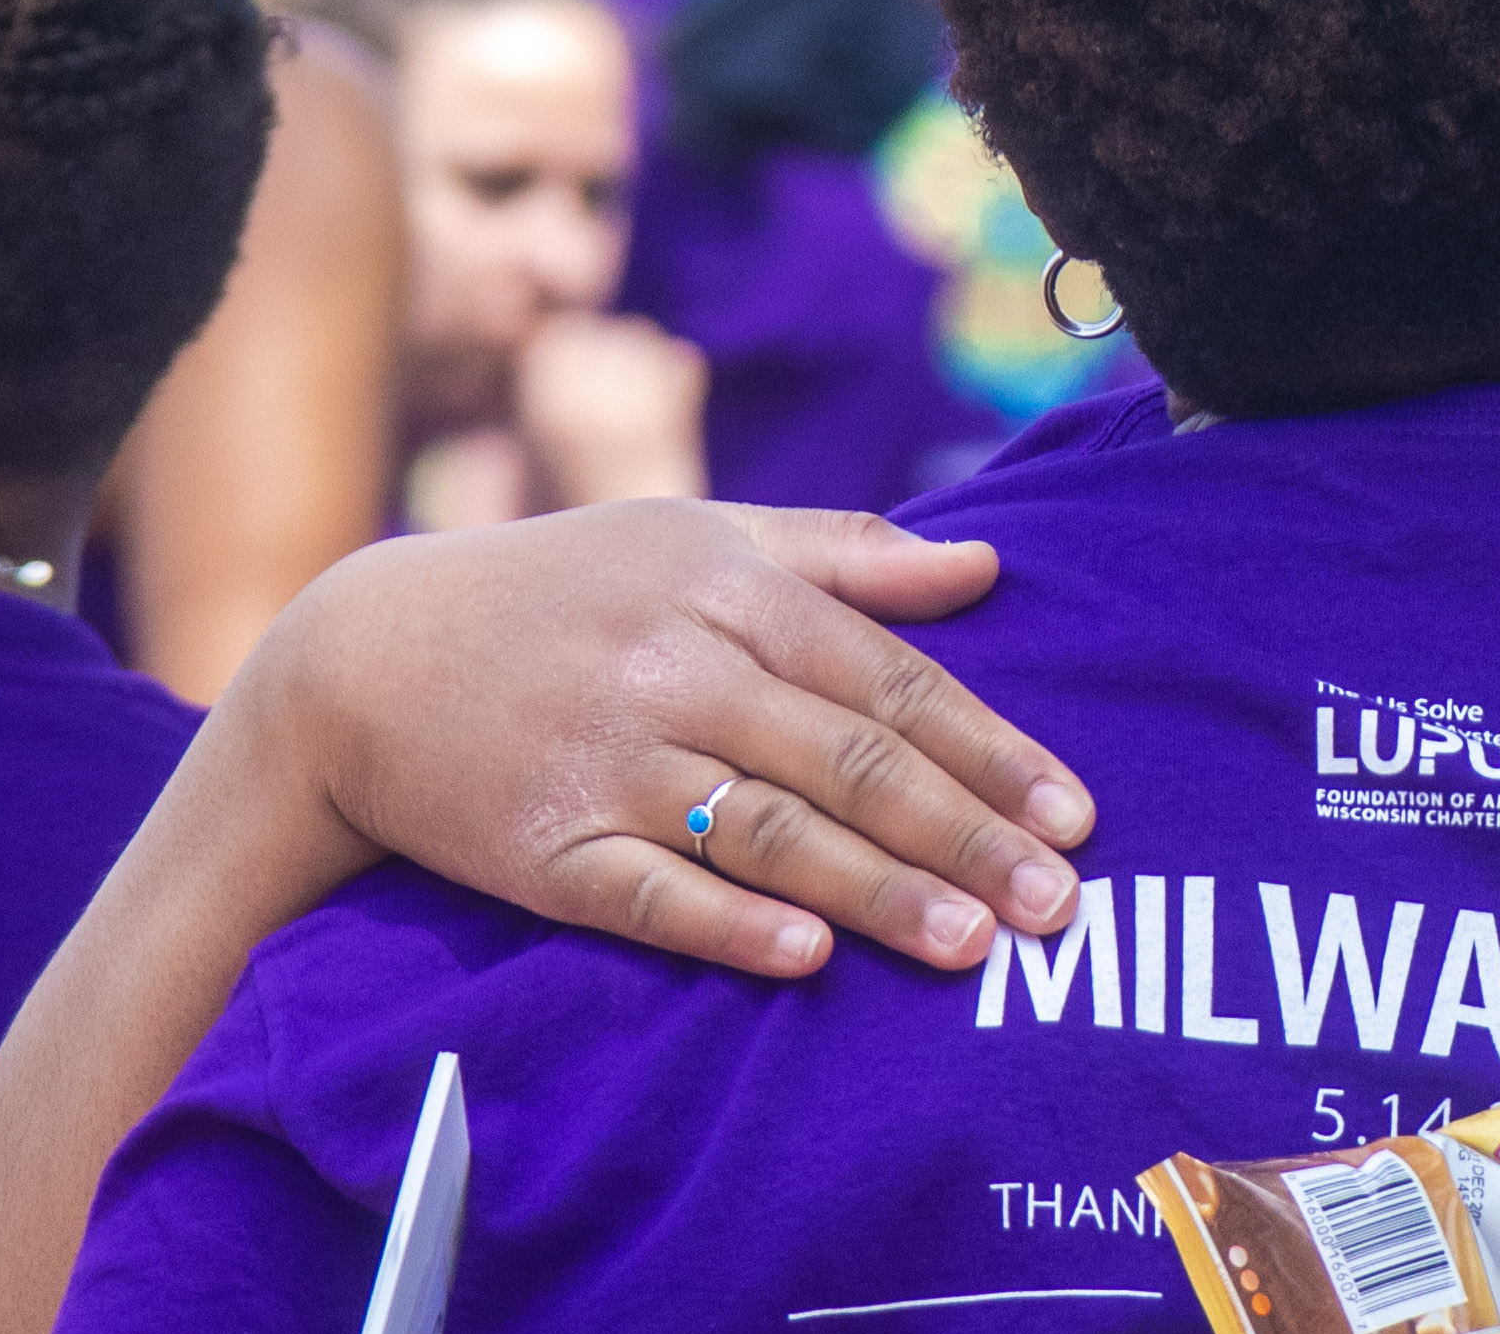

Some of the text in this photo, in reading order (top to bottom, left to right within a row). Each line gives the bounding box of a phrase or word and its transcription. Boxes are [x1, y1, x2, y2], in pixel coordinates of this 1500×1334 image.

[1414, 697, 1484, 723] Solve
[1315, 787, 1444, 808] FOUNDATION
[1449, 792, 1476, 809] OF
[1315, 803, 1421, 825] WISCONSIN
[1457, 1147, 1470, 1162] G
[1471, 1162, 1485, 1200] DEC
[1286, 1171, 1367, 1330] 0 16000 16609 7
